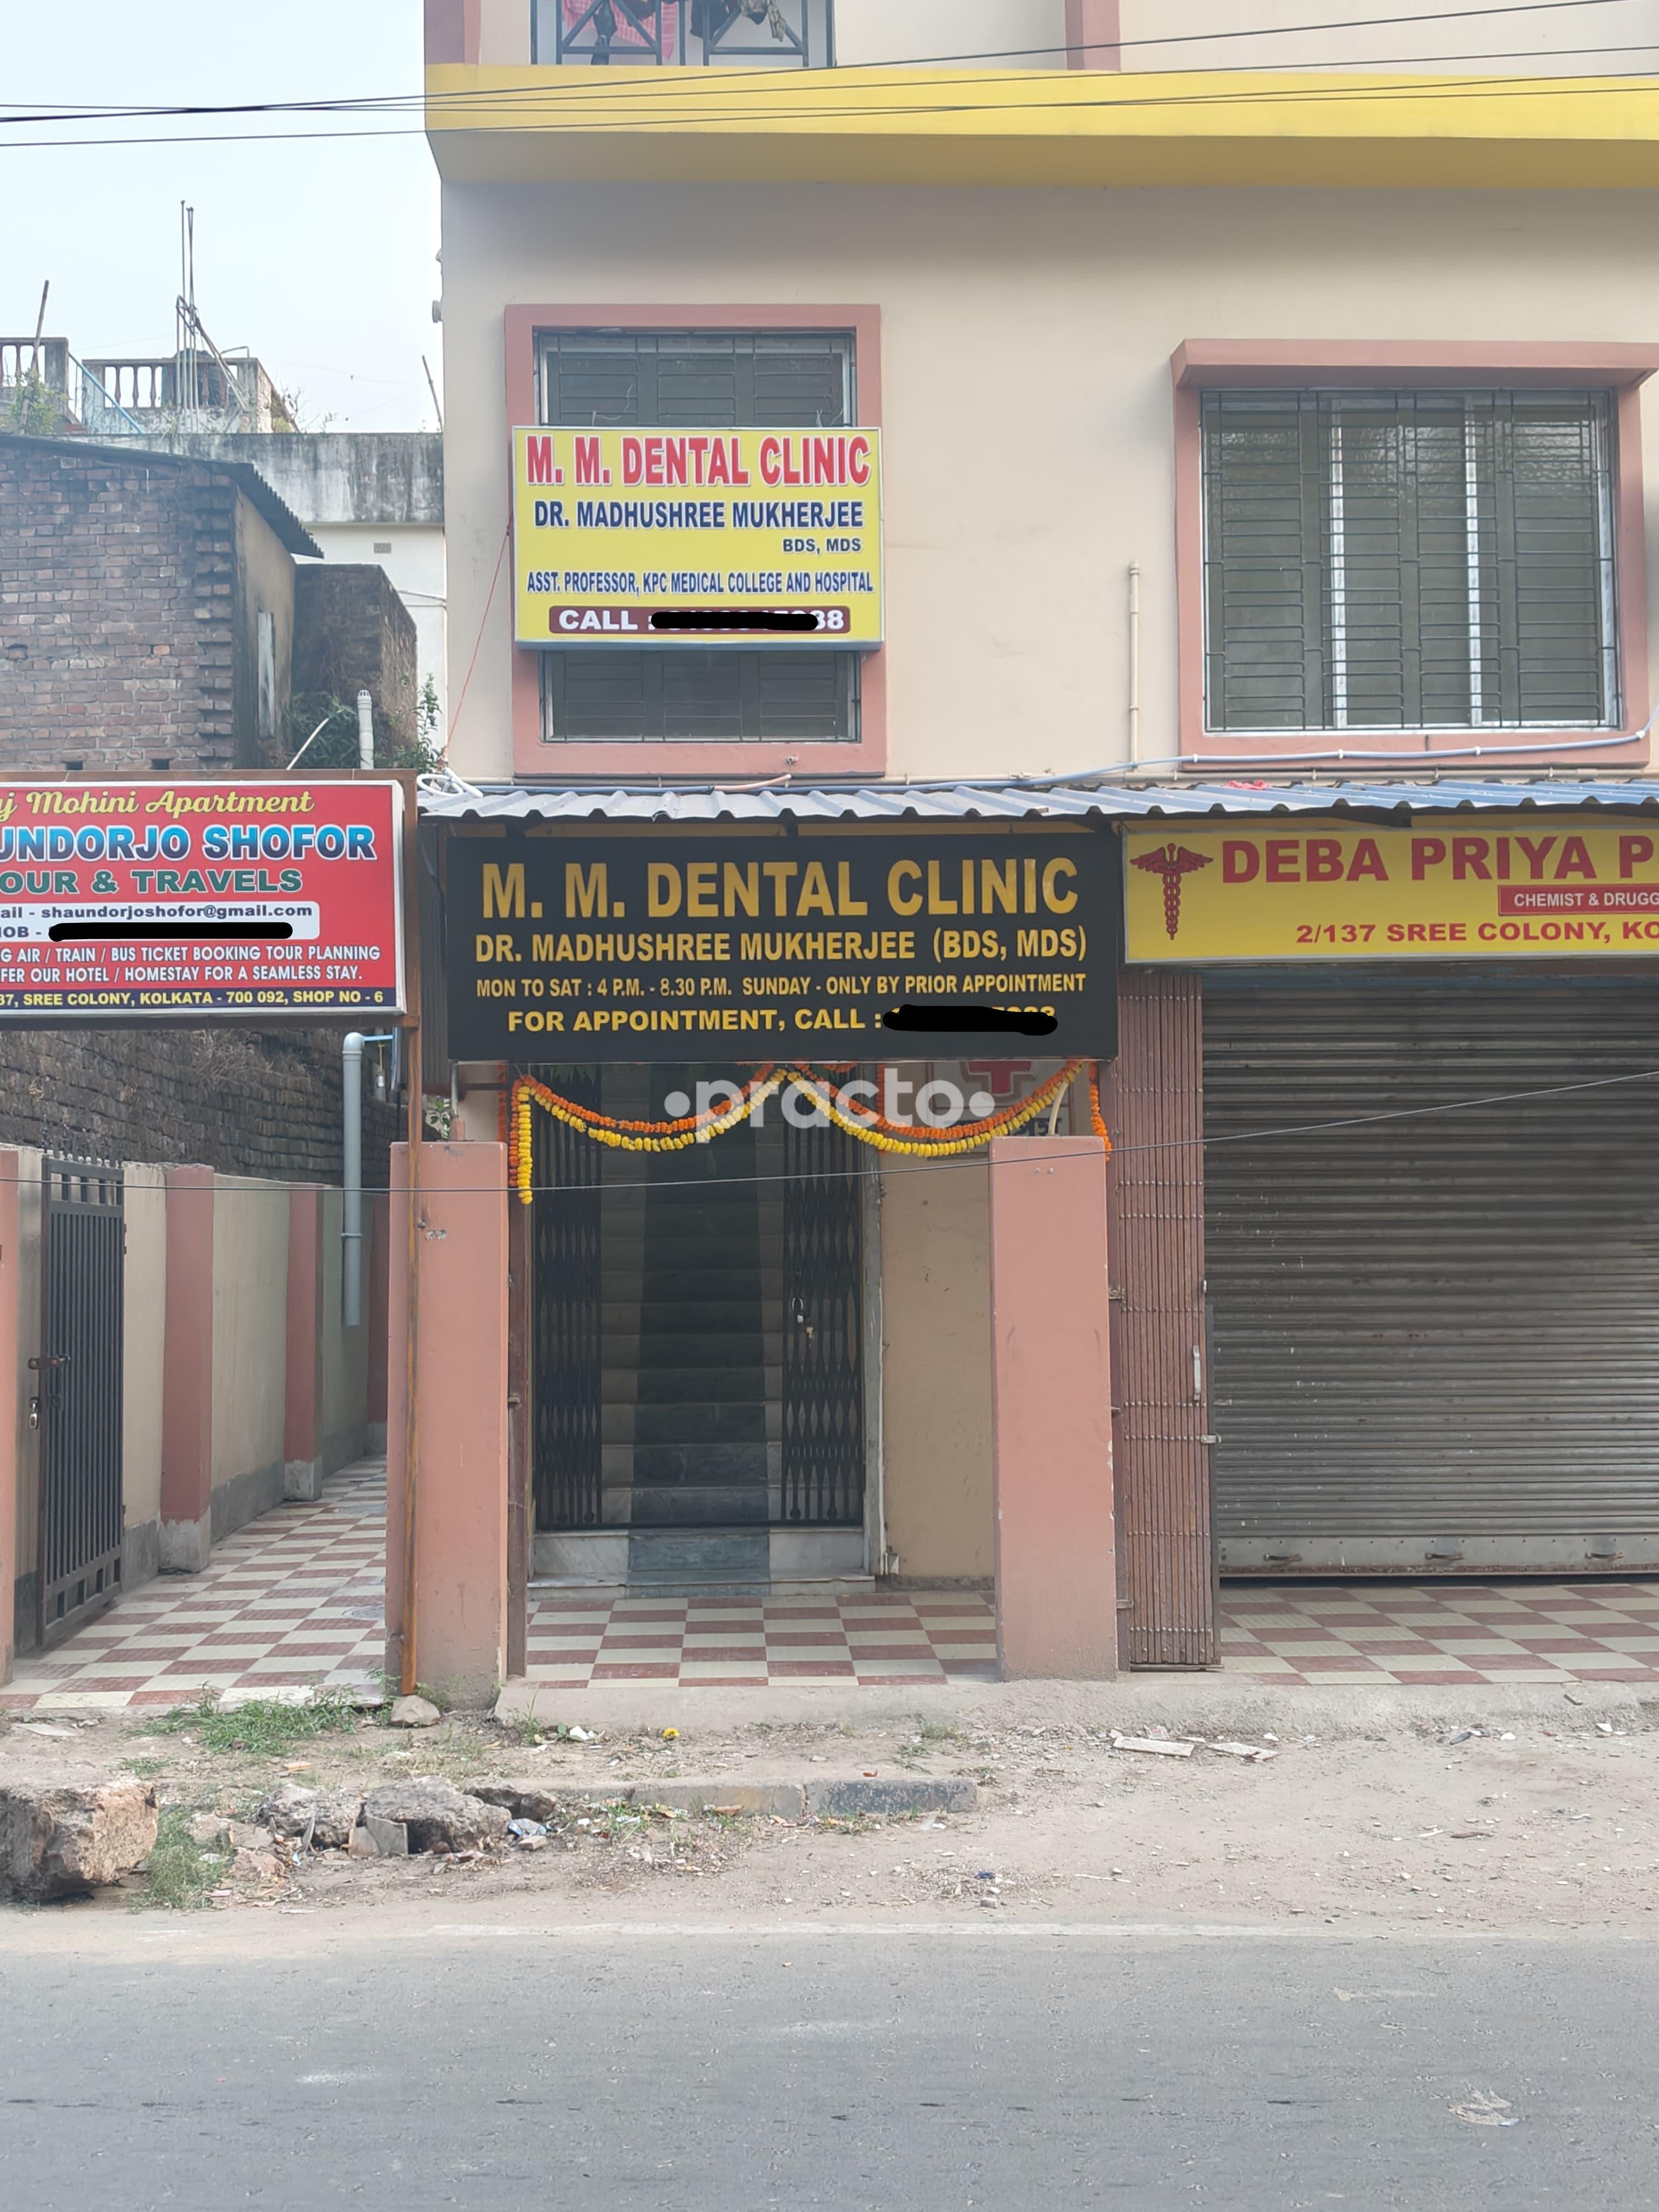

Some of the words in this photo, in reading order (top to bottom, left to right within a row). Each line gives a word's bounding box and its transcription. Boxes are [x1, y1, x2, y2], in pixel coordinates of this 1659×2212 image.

[527, 436, 563, 484] M.
[574, 436, 611, 484] M.
[622, 437, 749, 485] DENTAL
[760, 436, 871, 485] CLINIC
[534, 500, 569, 527] DR.
[577, 501, 725, 528] MADHUSHREE
[733, 501, 864, 528] MUKHERJEE
[782, 538, 820, 555] BDS,
[826, 538, 861, 552] MDS
[527, 571, 559, 592] ASST.
[564, 572, 639, 597] PROFESSOR,
[643, 572, 667, 593] KPC
[671, 572, 724, 593] MEDICAL
[728, 572, 782, 593] COLLEGE
[786, 572, 811, 592] AND
[815, 571, 873, 592] HOSPITAL
[559, 610, 637, 630] CALL
[26, 791, 139, 814] Mohini
[145, 791, 315, 819] Apartment
[202, 824, 377, 861] SHOFOR
[1223, 839, 1390, 884] DEBA
[1411, 836, 1597, 881] PRIYA
[0, 870, 79, 894] OUR
[91, 869, 119, 894] &
[131, 868, 302, 893] TRAVELS
[483, 863, 543, 918] M.
[565, 863, 625, 917] M.
[648, 861, 868, 917] DENTAL
[887, 858, 1078, 916] CLINIC
[1514, 893, 1584, 907] CHEMIST
[1589, 893, 1600, 906] &
[1604, 892, 1659, 906] DRUGG
[41, 905, 312, 920] shaundorjoshofor@gmail.com
[476, 934, 522, 962] DR.
[532, 933, 731, 962] MADHUSHREE
[740, 931, 915, 961] MUKHERJEE
[933, 927, 1007, 963] (BDS,
[1017, 925, 1087, 961] MDS)
[1297, 925, 1376, 943] 2/137
[1387, 923, 1467, 942] SREE
[1478, 921, 1611, 944] COLONY,
[17, 948, 41, 962] AIR
[45, 947, 51, 964] /
[56, 948, 96, 962] TRAIN
[100, 947, 106, 963] /
[112, 948, 136, 962] BUS
[141, 947, 188, 961] TICKET
[193, 946, 261, 961] BOOKING
[266, 946, 302, 960] TOUR
[308, 946, 381, 960] PLANNING
[30, 967, 60, 983] OUR
[66, 967, 109, 982] HOTEL
[114, 967, 120, 983] /
[125, 966, 199, 982] HOMESTAY
[205, 966, 232, 981] FOR
[238, 966, 248, 981] A
[253, 965, 321, 980] SEAMLESS
[326, 965, 362, 980] STAY.
[476, 979, 516, 997] MON
[521, 979, 544, 997] TO
[549, 979, 582, 997] SAT
[597, 979, 608, 996] 4
[613, 979, 645, 996] P.M.
[660, 978, 695, 996] 8.30
[700, 977, 732, 995] P.M.
[742, 976, 811, 996] SUNDAY
[826, 976, 871, 995] ONLY
[876, 976, 900, 994] BY
[905, 975, 957, 994] PRIOR
[962, 973, 1086, 993] APPOINTMENT
[23, 993, 63, 1006] SREE
[67, 993, 135, 1007] COLONY,
[140, 992, 213, 1005] KOLKATA
[226, 992, 253, 1004] 700
[257, 991, 288, 1005] 092,
[293, 990, 334, 1003] SHOP
[339, 990, 361, 1003] NO
[374, 990, 383, 1003] 6
[508, 1011, 564, 1031] FOR
[573, 1009, 785, 1032] APPOINTMENT,
[794, 1008, 866, 1029] CALL
